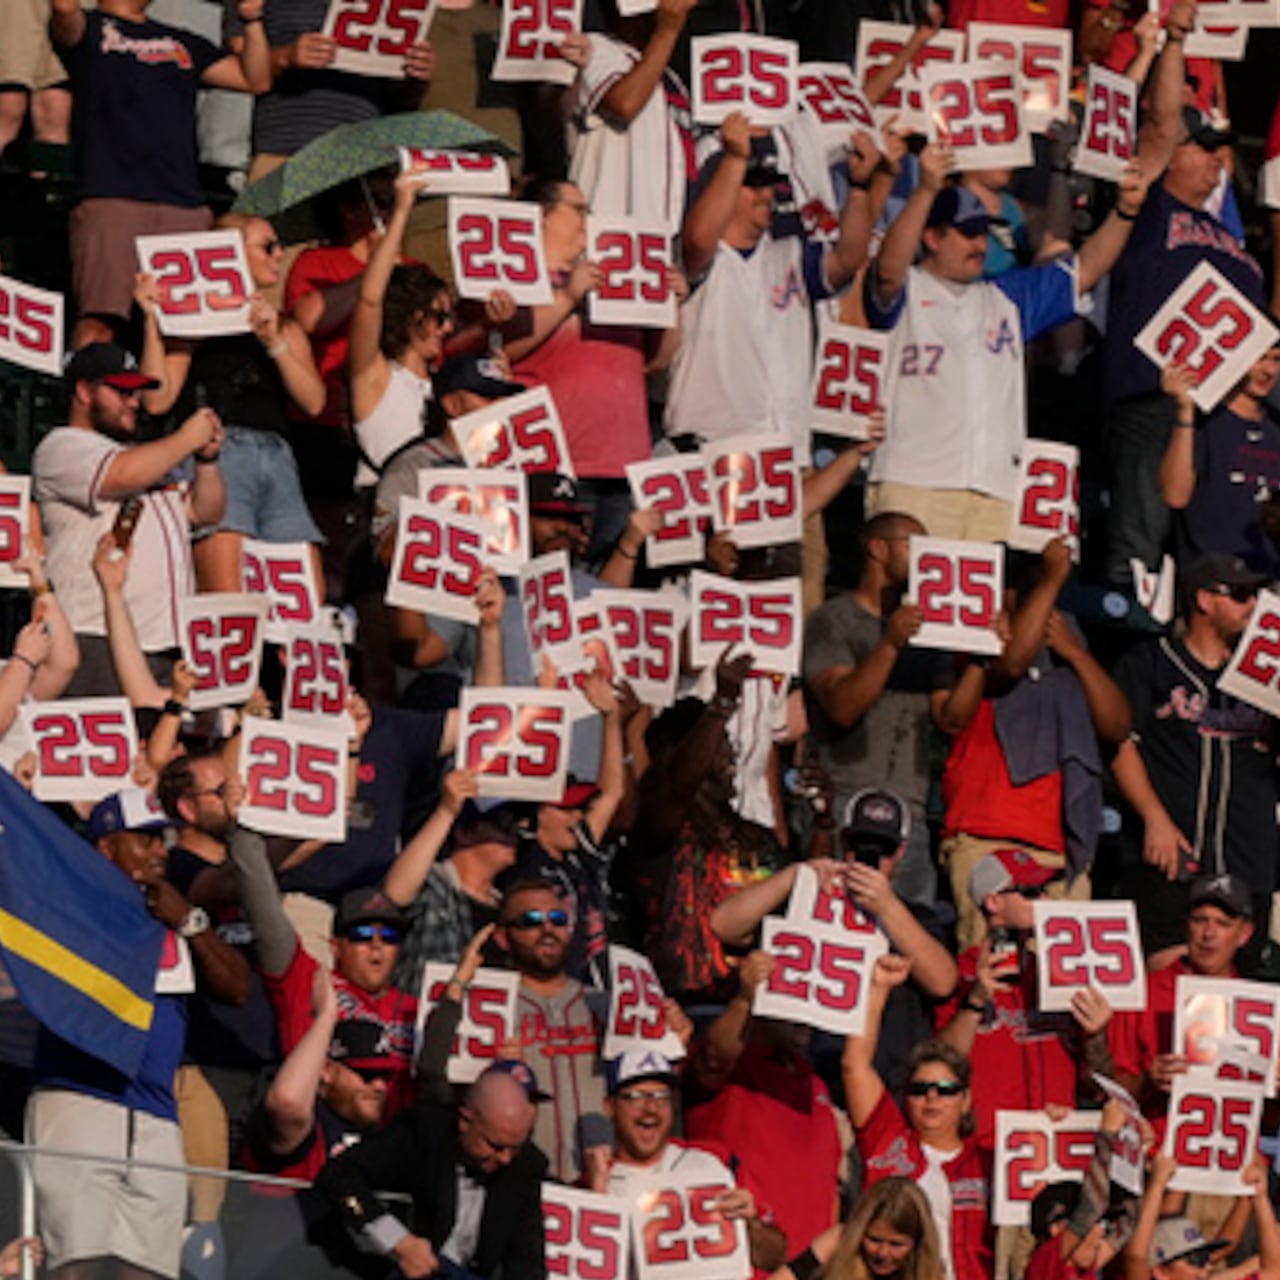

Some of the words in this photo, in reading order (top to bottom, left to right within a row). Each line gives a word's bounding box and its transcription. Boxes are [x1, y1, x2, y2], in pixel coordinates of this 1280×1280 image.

[332, 0, 422, 56] 25
[507, 0, 571, 60] 25
[701, 47, 790, 106] 25
[799, 72, 871, 126] 25
[930, 75, 1020, 144] 25
[1086, 82, 1131, 158] 25
[151, 249, 247, 314] 25
[458, 215, 539, 284] 25
[596, 233, 668, 301] 25
[900, 344, 944, 375] 27
[1158, 281, 1252, 385] 25
[816, 341, 882, 413] 25
[713, 449, 794, 522] 25
[401, 516, 482, 596] 25
[919, 554, 993, 628] 25
[523, 571, 572, 650] 25
[608, 609, 672, 680] 25
[701, 590, 791, 646] 25
[293, 640, 345, 713] 25
[32, 714, 130, 776] 25
[248, 736, 338, 816] 25
[468, 705, 563, 776] 25
[770, 933, 864, 1010] 25
[1046, 918, 1131, 986] 25
[614, 965, 664, 1039] 25
[1007, 1130, 1092, 1200] 25
[1177, 1095, 1251, 1170] 25
[643, 1184, 737, 1263] 25
